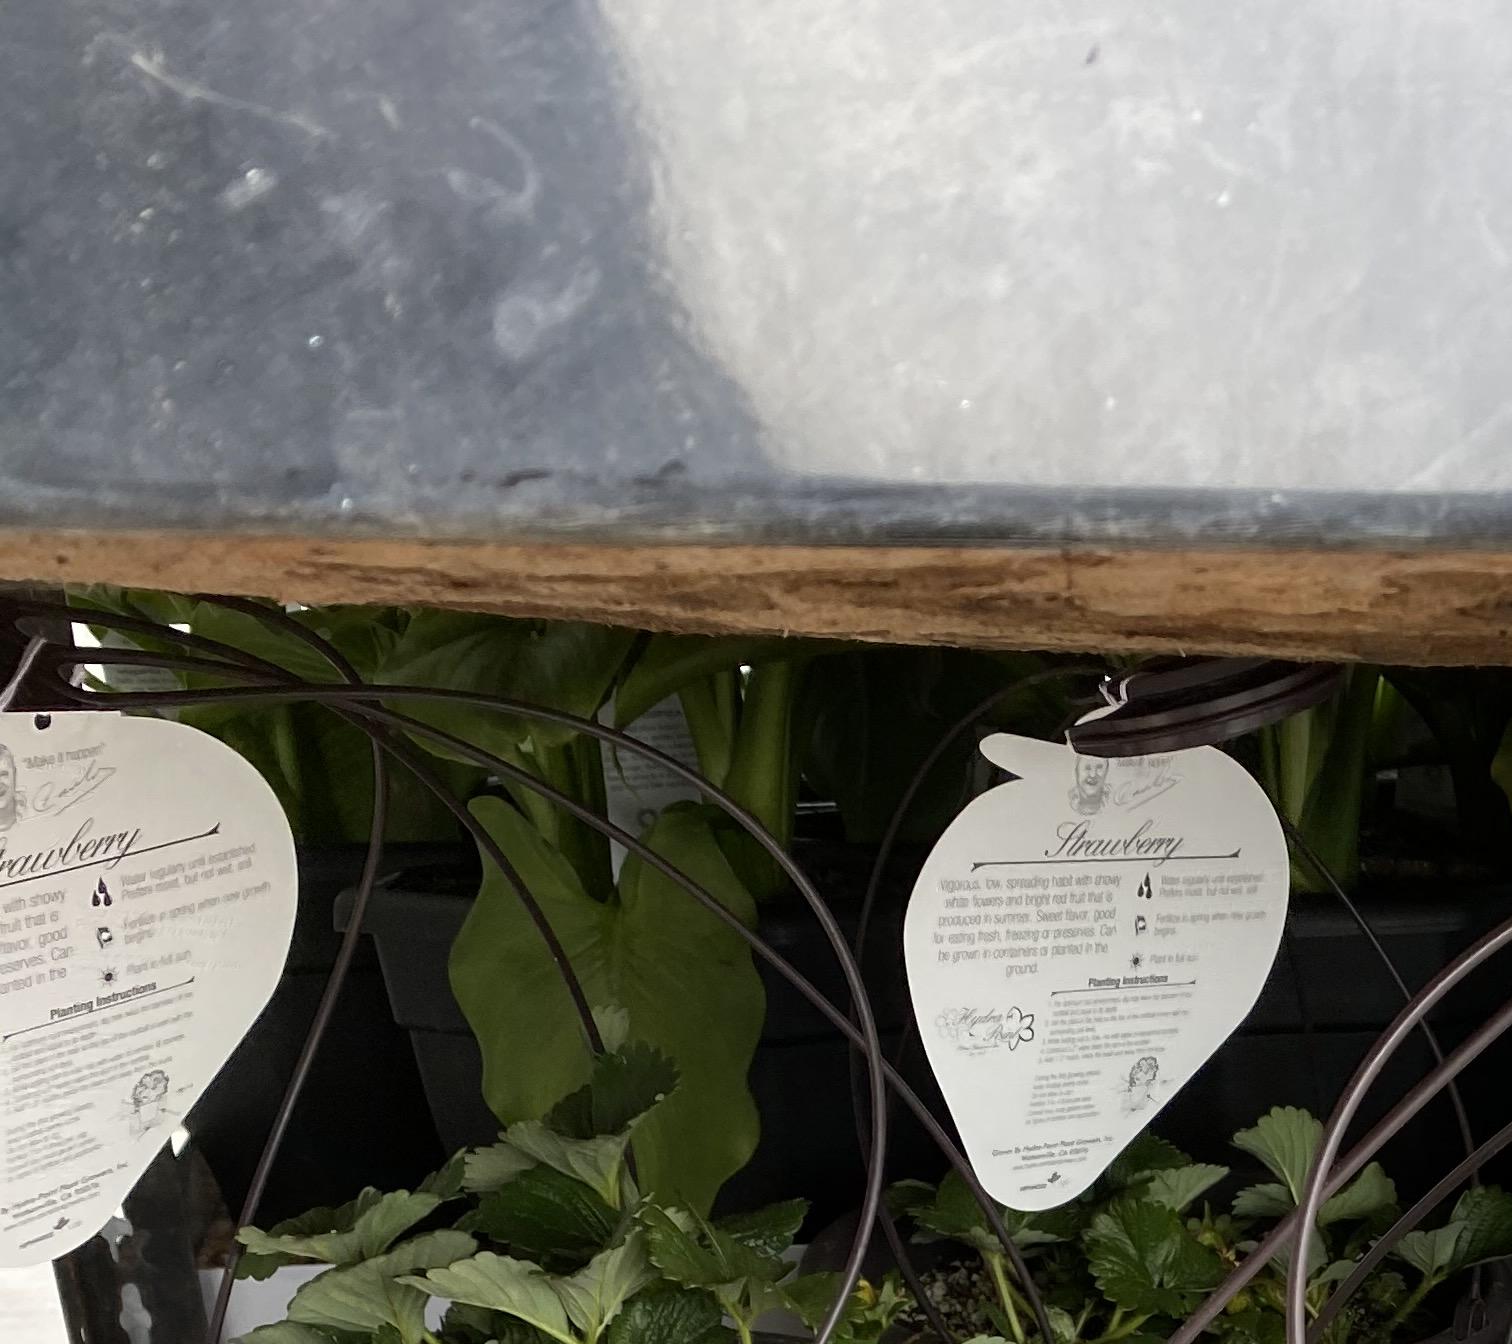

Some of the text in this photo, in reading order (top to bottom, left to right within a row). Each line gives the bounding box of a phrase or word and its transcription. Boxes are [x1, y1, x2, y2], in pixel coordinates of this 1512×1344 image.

[0, 817, 142, 877] rawberry
[1044, 818, 1184, 868] Strawberry
[938, 914, 981, 928] produced
[1036, 909, 1063, 922] Sweet
[1094, 906, 1116, 922] good
[39, 927, 68, 948] good
[1100, 923, 1117, 937] Can
[952, 950, 980, 964] grown
[1088, 975, 1168, 989] Planting Instructions
[50, 981, 157, 1021] Planting Instructions
[958, 1007, 1003, 1029] Hydra
